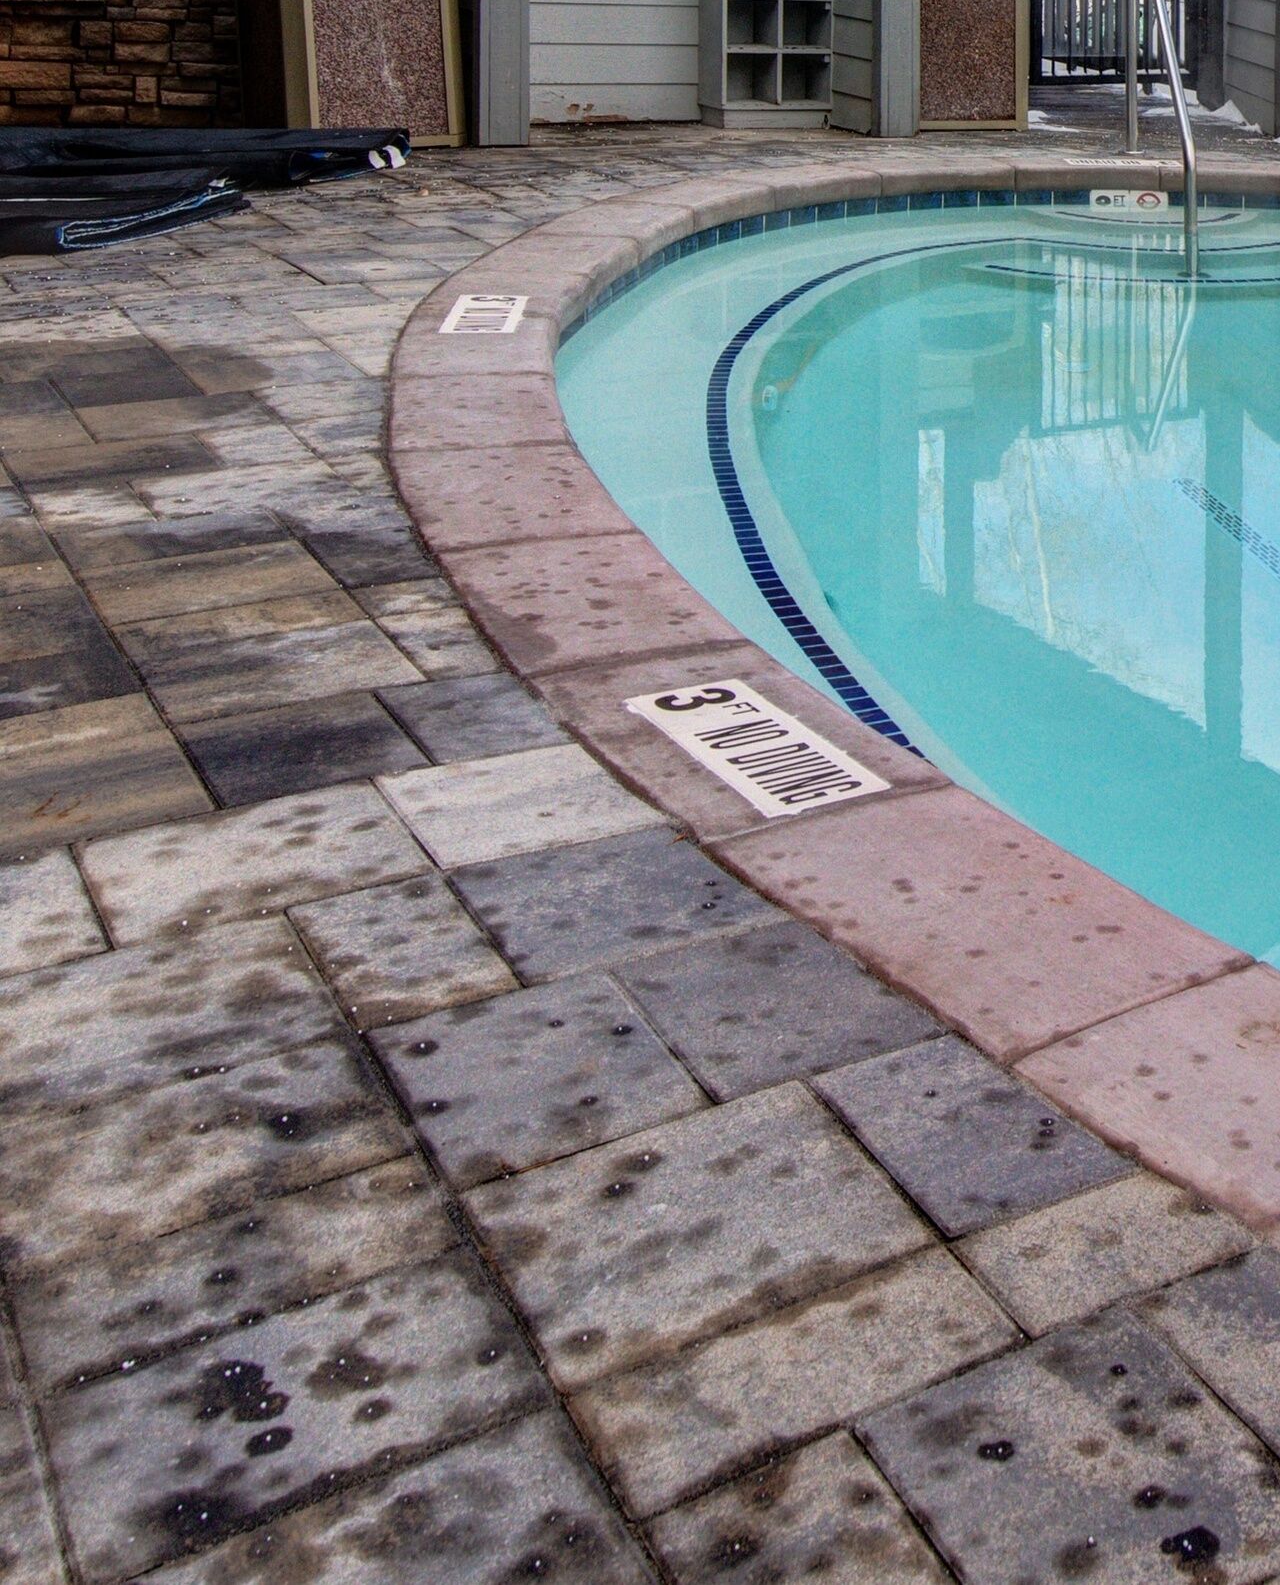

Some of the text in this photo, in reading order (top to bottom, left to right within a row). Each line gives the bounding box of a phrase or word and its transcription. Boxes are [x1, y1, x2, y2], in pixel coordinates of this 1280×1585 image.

[654, 688, 863, 806] 3 FT NO DIVING
